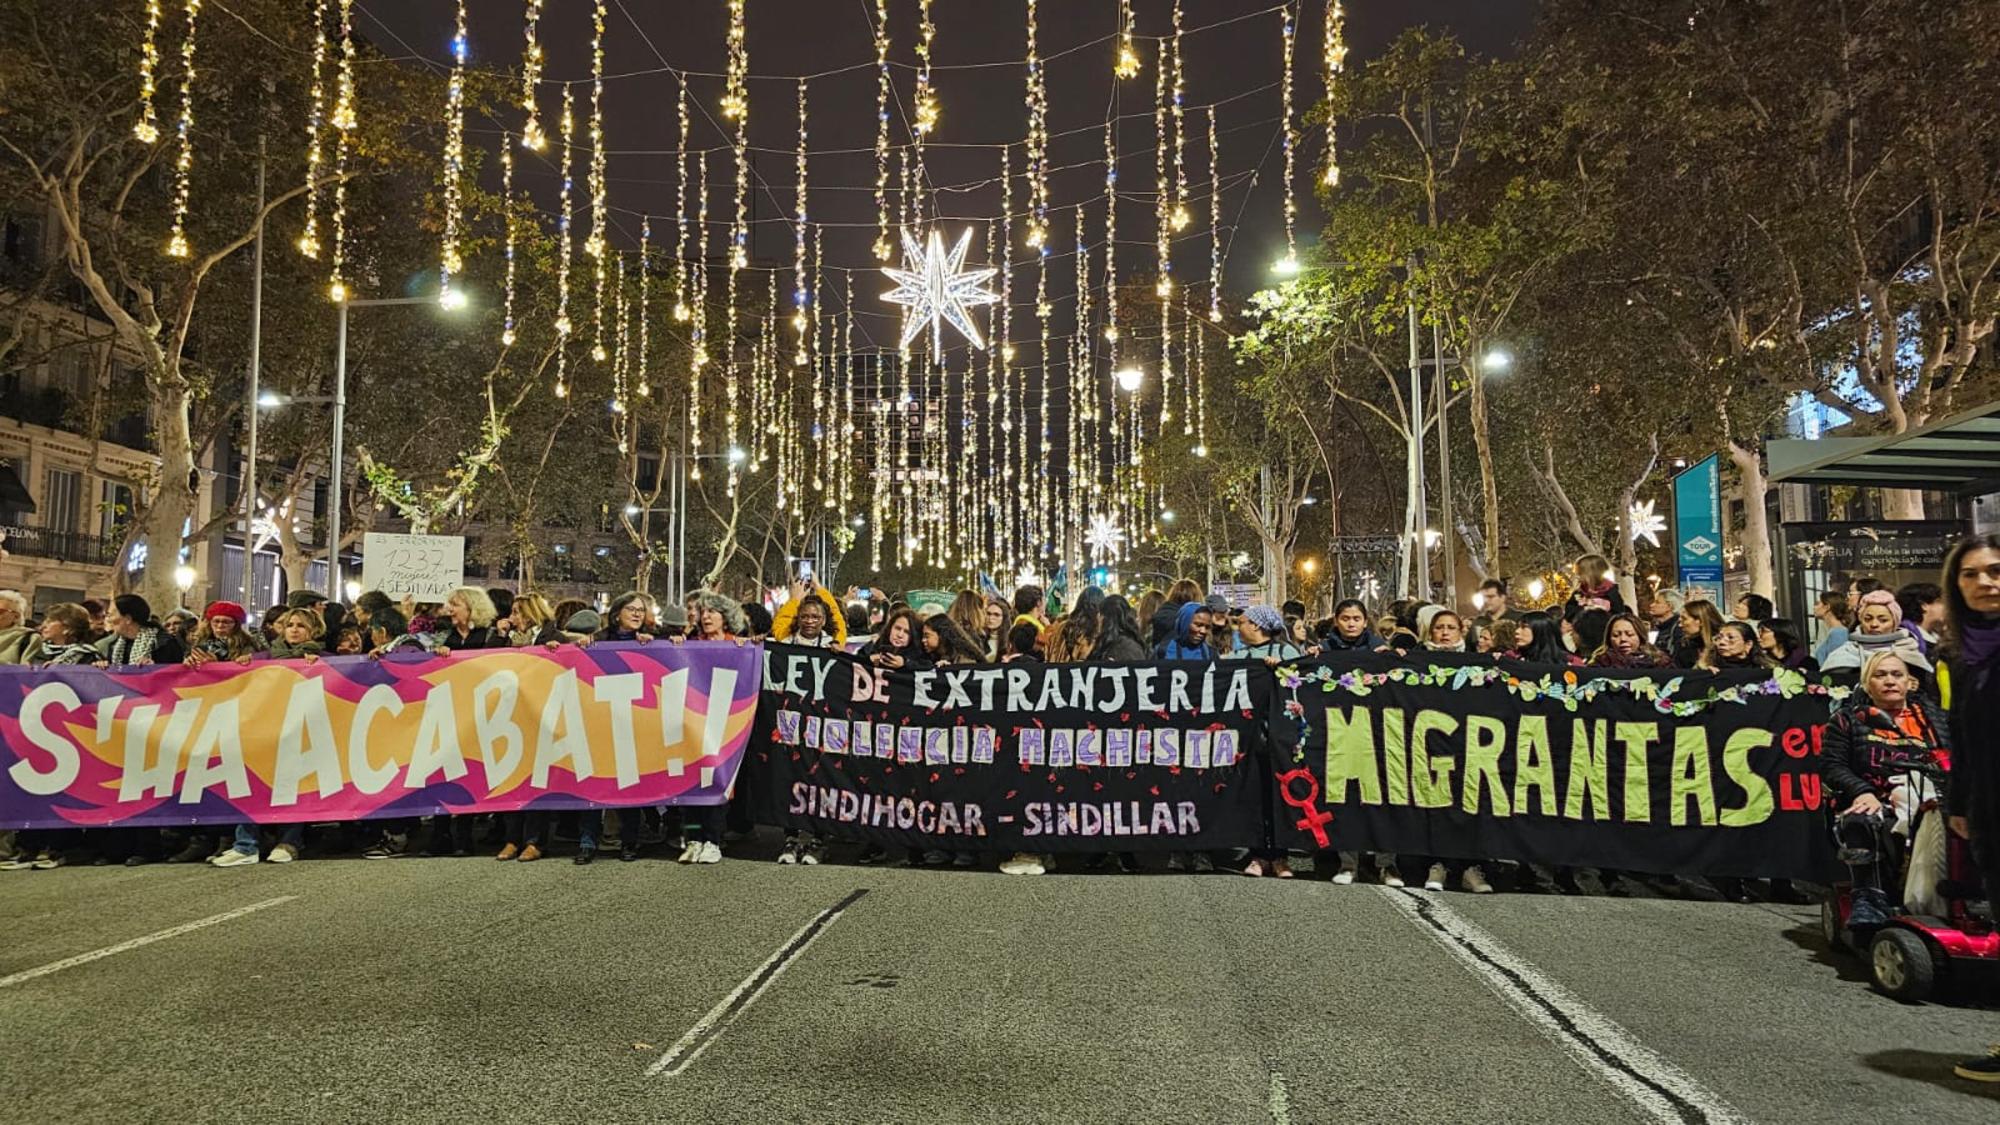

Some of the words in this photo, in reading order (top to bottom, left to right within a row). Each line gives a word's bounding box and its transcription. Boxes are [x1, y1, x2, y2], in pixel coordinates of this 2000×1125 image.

[762, 649, 837, 701] LEY
[850, 664, 891, 703] DE
[913, 661, 1254, 714] EXTRANJERÍA
[8, 681, 252, 804] S'HA
[270, 667, 738, 807] ACABAT!!
[776, 709, 997, 766] VIOLENCIA
[1018, 727, 1239, 768] MACHISTA
[1324, 705, 1776, 827] MIGRANTAS
[789, 782, 987, 836] SINDIHOGAR
[1022, 801, 1200, 836] SINDILLAR
